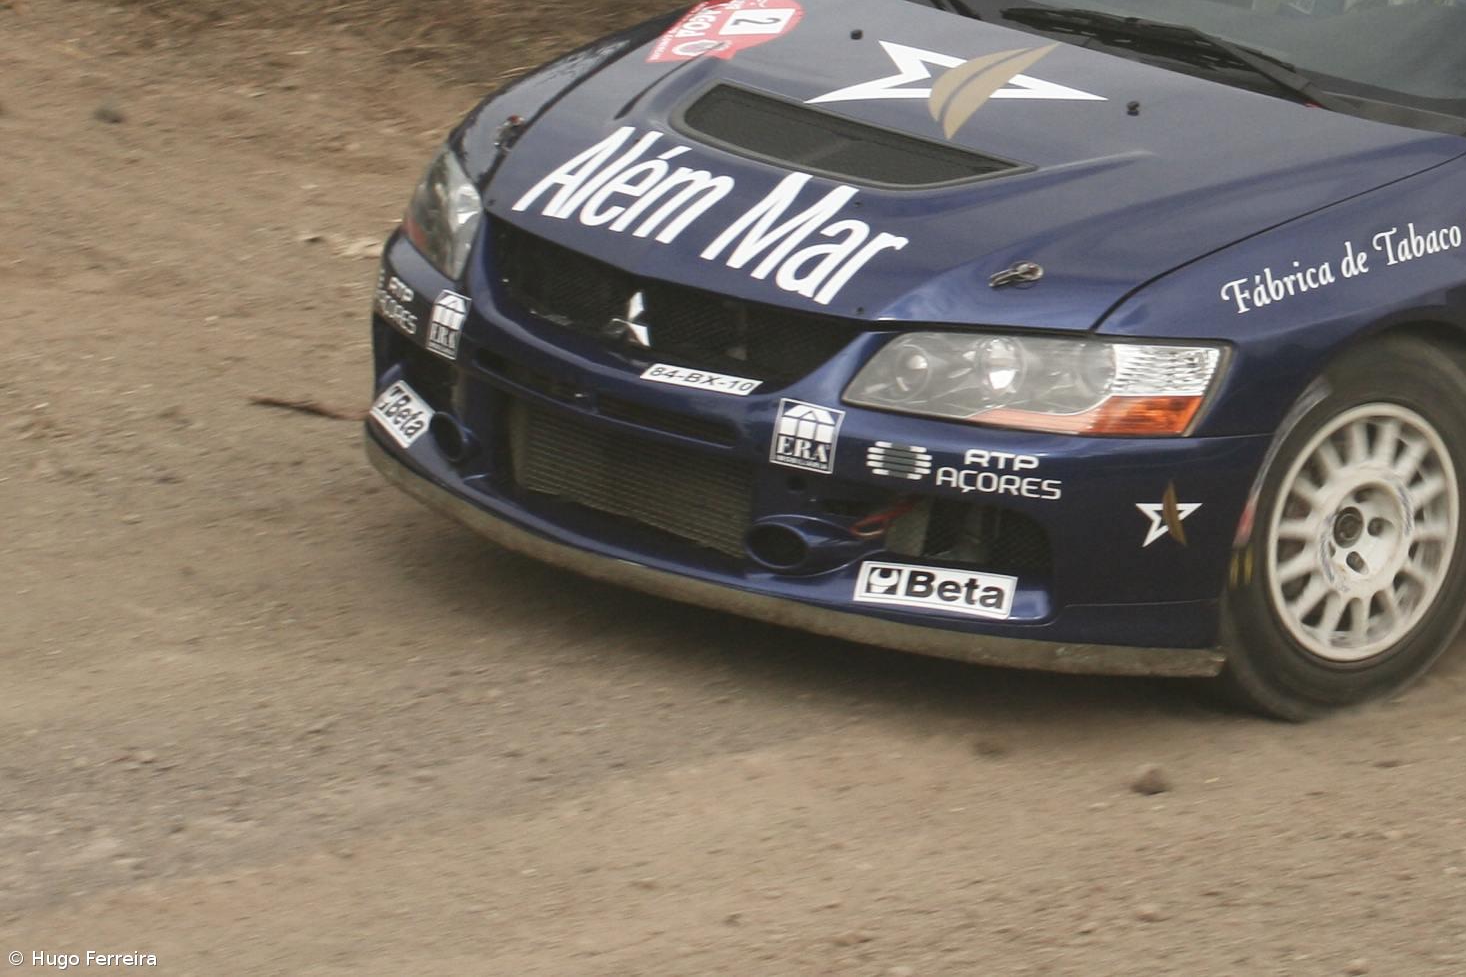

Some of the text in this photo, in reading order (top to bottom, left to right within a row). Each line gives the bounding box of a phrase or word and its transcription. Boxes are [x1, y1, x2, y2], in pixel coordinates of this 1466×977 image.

[511, 126, 909, 306] Além Mar
[1220, 261, 1335, 314] Fábrica
[1340, 241, 1369, 278] de
[1372, 223, 1462, 266] Tabaco
[650, 366, 755, 392] 84-BX-10
[383, 393, 424, 439] Beta
[776, 436, 829, 463] ERA
[964, 449, 1039, 471] RTP
[935, 466, 1062, 500] AÇORES
[905, 570, 1006, 609] Beta
